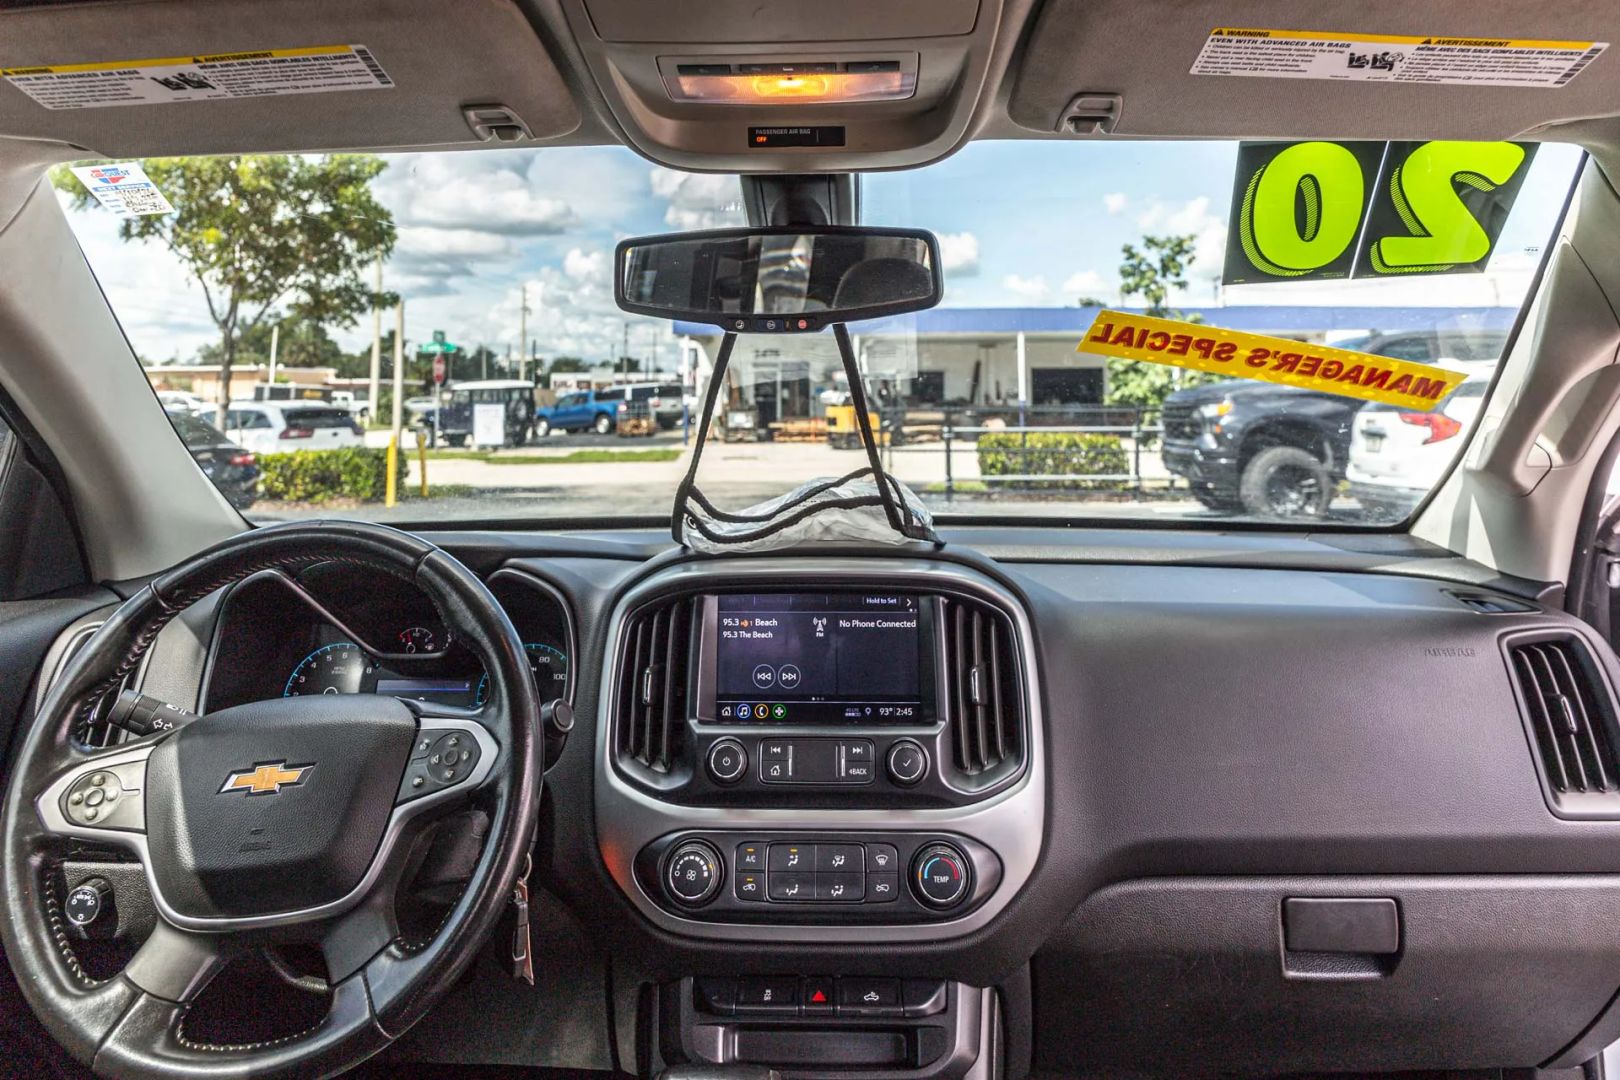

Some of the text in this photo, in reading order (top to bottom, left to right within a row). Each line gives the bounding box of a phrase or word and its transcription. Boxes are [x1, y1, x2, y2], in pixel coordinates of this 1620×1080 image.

[1434, 39, 1511, 48] AVERTISSEMENT
[723, 618, 739, 626] 95.3
[755, 618, 778, 627] Beach
[840, 619, 916, 628] No Phone Connected
[722, 631, 773, 639] 95.3 The Beach
[553, 673, 567, 681] 100
[879, 707, 913, 716] 93° 2:45
[852, 767, 867, 775] BACK
